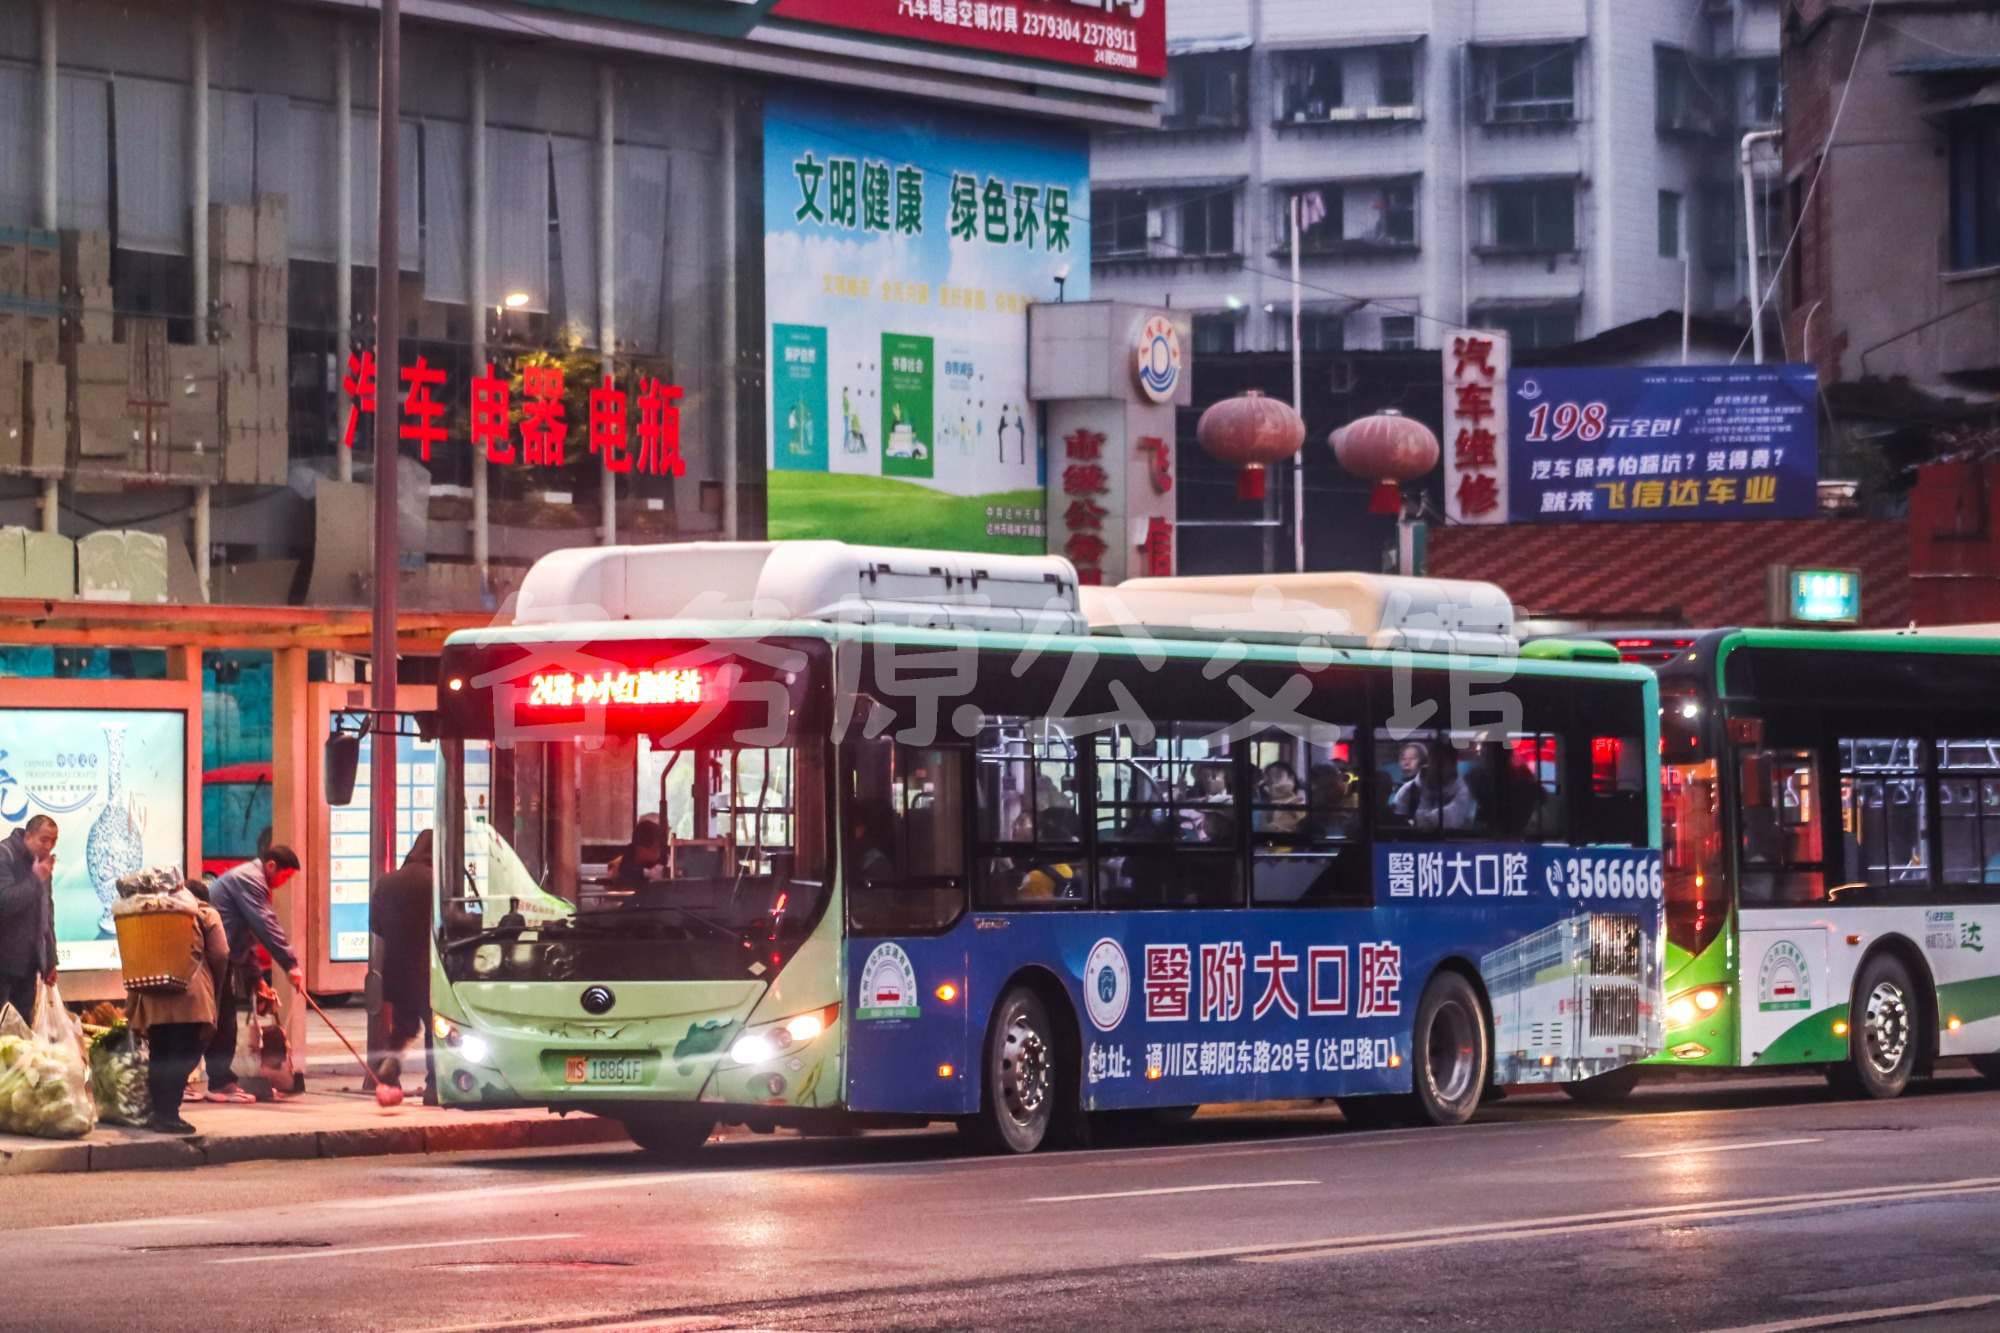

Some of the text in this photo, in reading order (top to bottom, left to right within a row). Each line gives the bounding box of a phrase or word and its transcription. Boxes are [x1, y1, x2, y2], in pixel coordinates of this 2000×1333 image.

[1023, 12, 1079, 43] 2379304
[1083, 22, 1137, 52] 2378911
[794, 152, 1071, 252] 文明健康 绿色环保
[471, 363, 568, 467] 电器
[590, 375, 685, 477] 电瓶
[1453, 335, 1500, 518] 汽车维修
[1706, 448, 1784, 472] 觉得贵？
[1388, 852, 1662, 899] 醫附大口腔 3566666
[1960, 921, 1984, 952] 达
[1144, 941, 1402, 1022] 醫附大口腔
